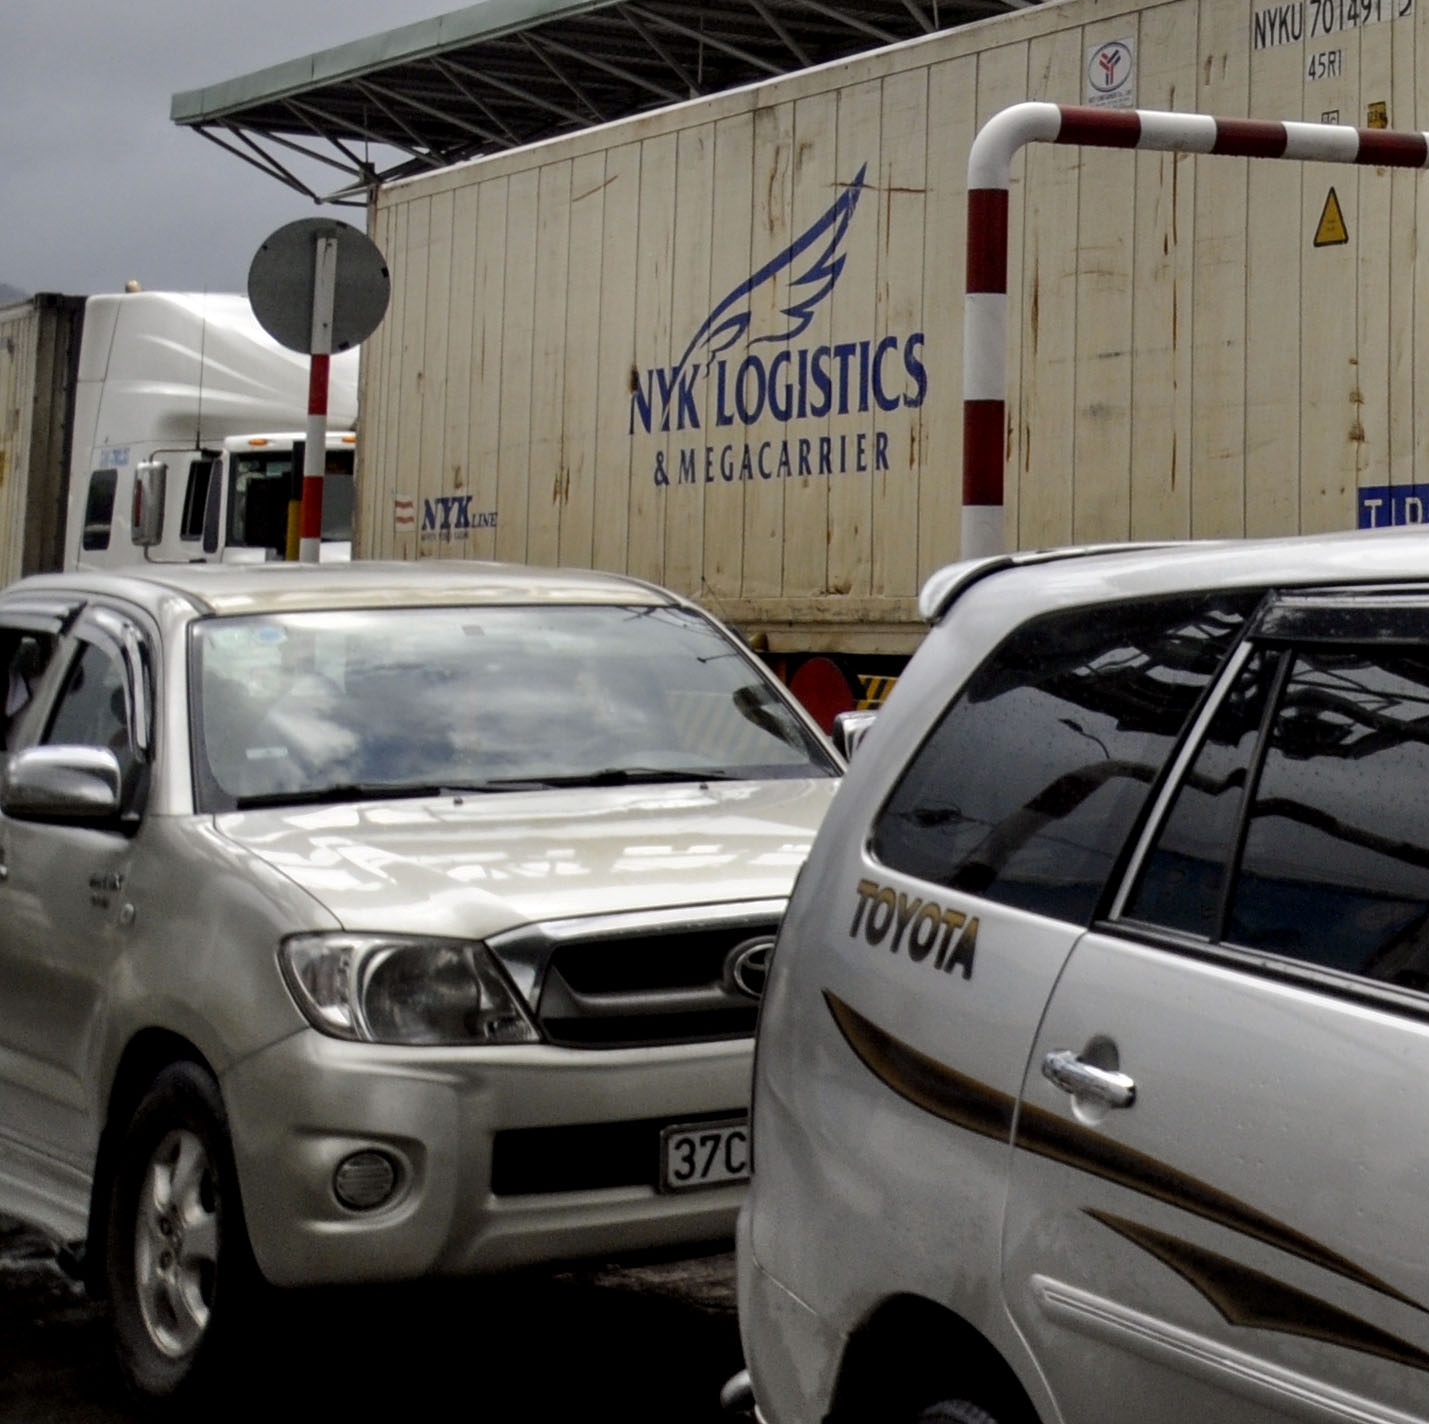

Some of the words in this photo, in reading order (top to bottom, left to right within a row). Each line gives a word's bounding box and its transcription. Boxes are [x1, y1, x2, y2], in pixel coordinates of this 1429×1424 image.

[1254, 0, 1304, 51] NYKU
[1308, 49, 1342, 81] 45R1
[629, 363, 702, 436] NYK
[716, 331, 928, 427] LOGISTICS
[653, 451, 669, 487] &
[679, 431, 890, 485] MEGACARRIER
[421, 495, 472, 532] NYK
[471, 511, 498, 529] LINE
[849, 878, 981, 981] TOYOTA
[673, 1131, 746, 1181] 37C
